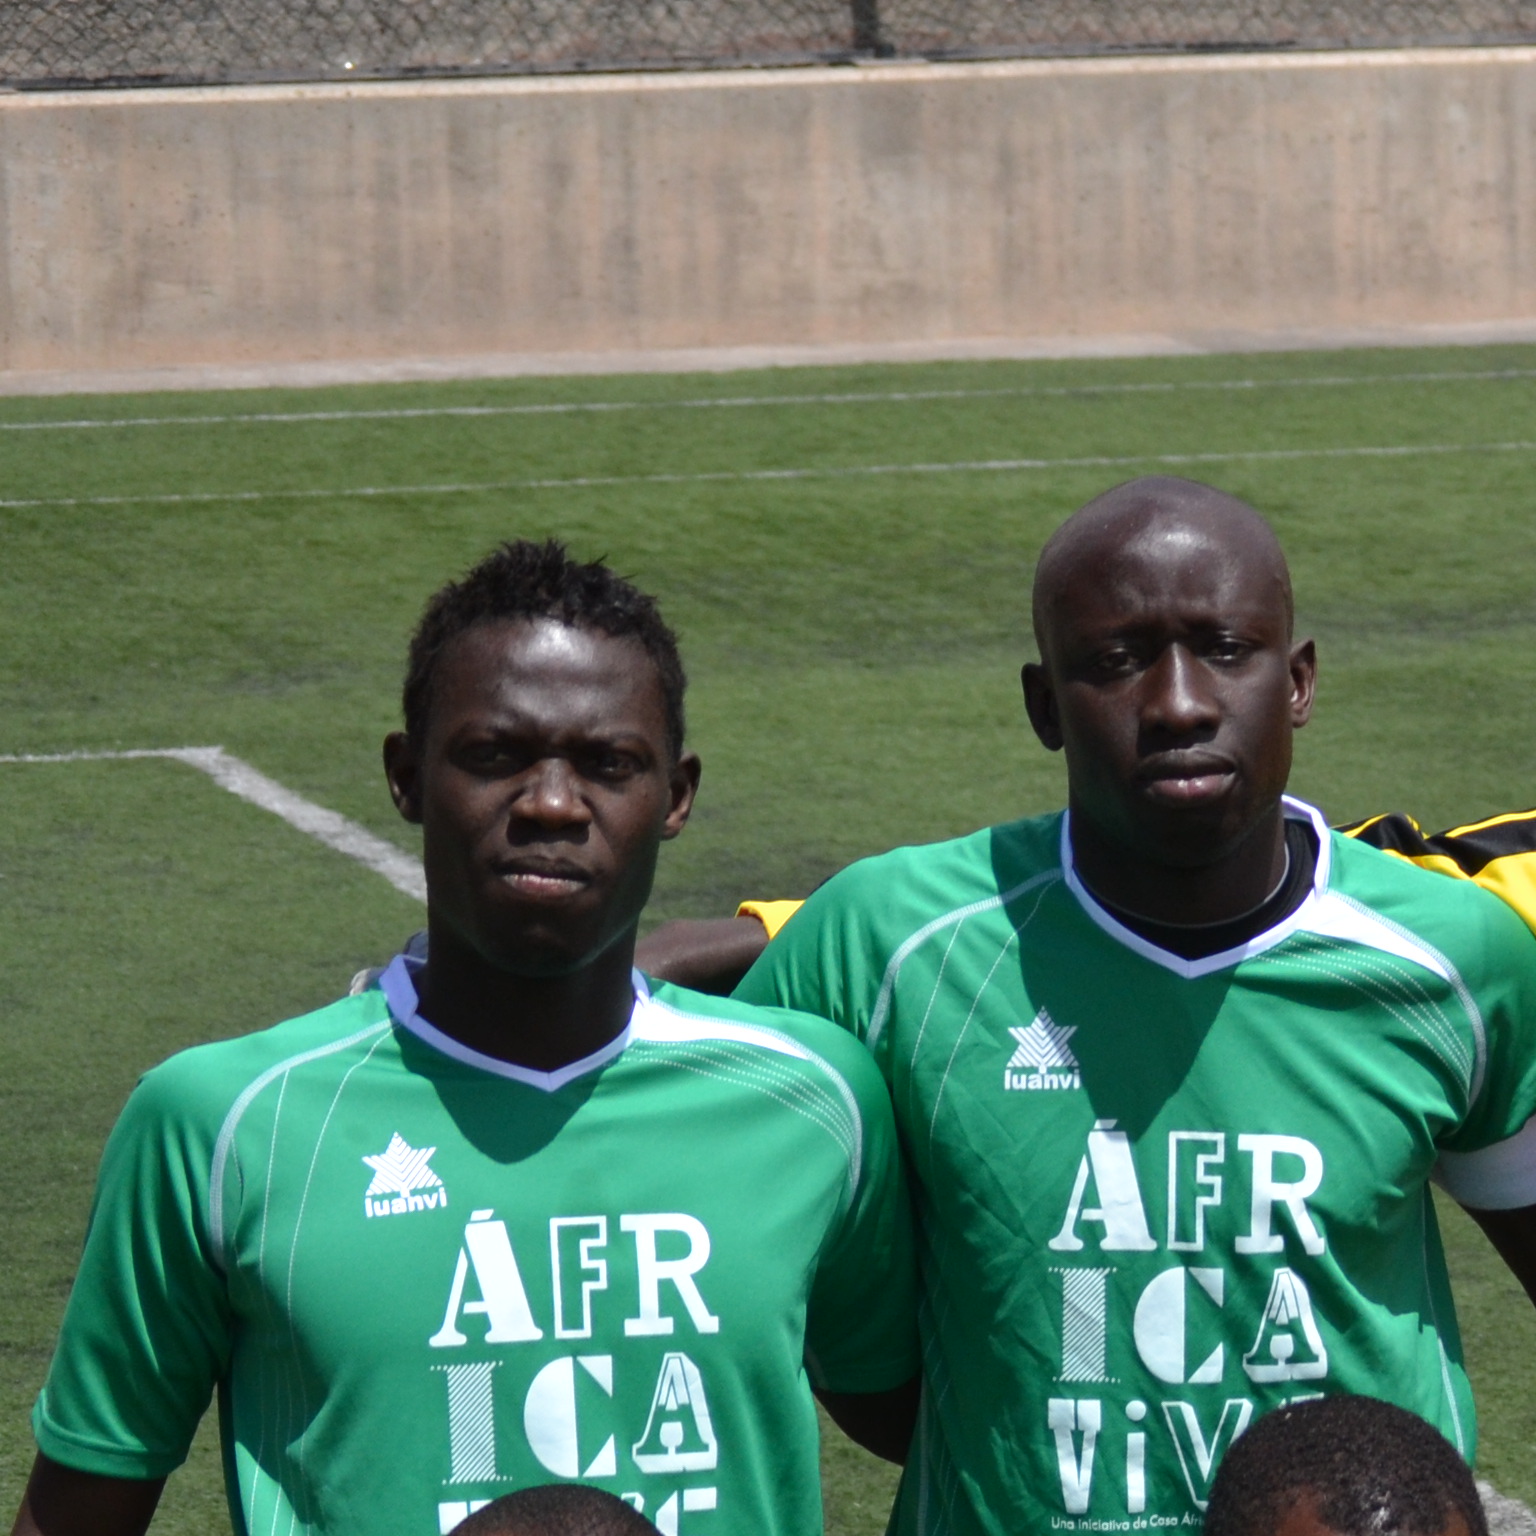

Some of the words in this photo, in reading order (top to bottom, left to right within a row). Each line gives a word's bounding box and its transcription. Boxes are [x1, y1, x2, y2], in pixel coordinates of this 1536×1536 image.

[1004, 1067, 1080, 1090] luanvi
[365, 1186, 447, 1218] luanvi
[1048, 1118, 1325, 1256] ÁFR
[429, 1208, 719, 1347] ÁFR
[1048, 1266, 1328, 1383] ICA
[430, 1352, 718, 1485] ICA
[1047, 1392, 1325, 1514] ViV
[1051, 1516, 1075, 1530] Una
[1133, 1517, 1147, 1529] de
[1150, 1514, 1178, 1527] Casa
